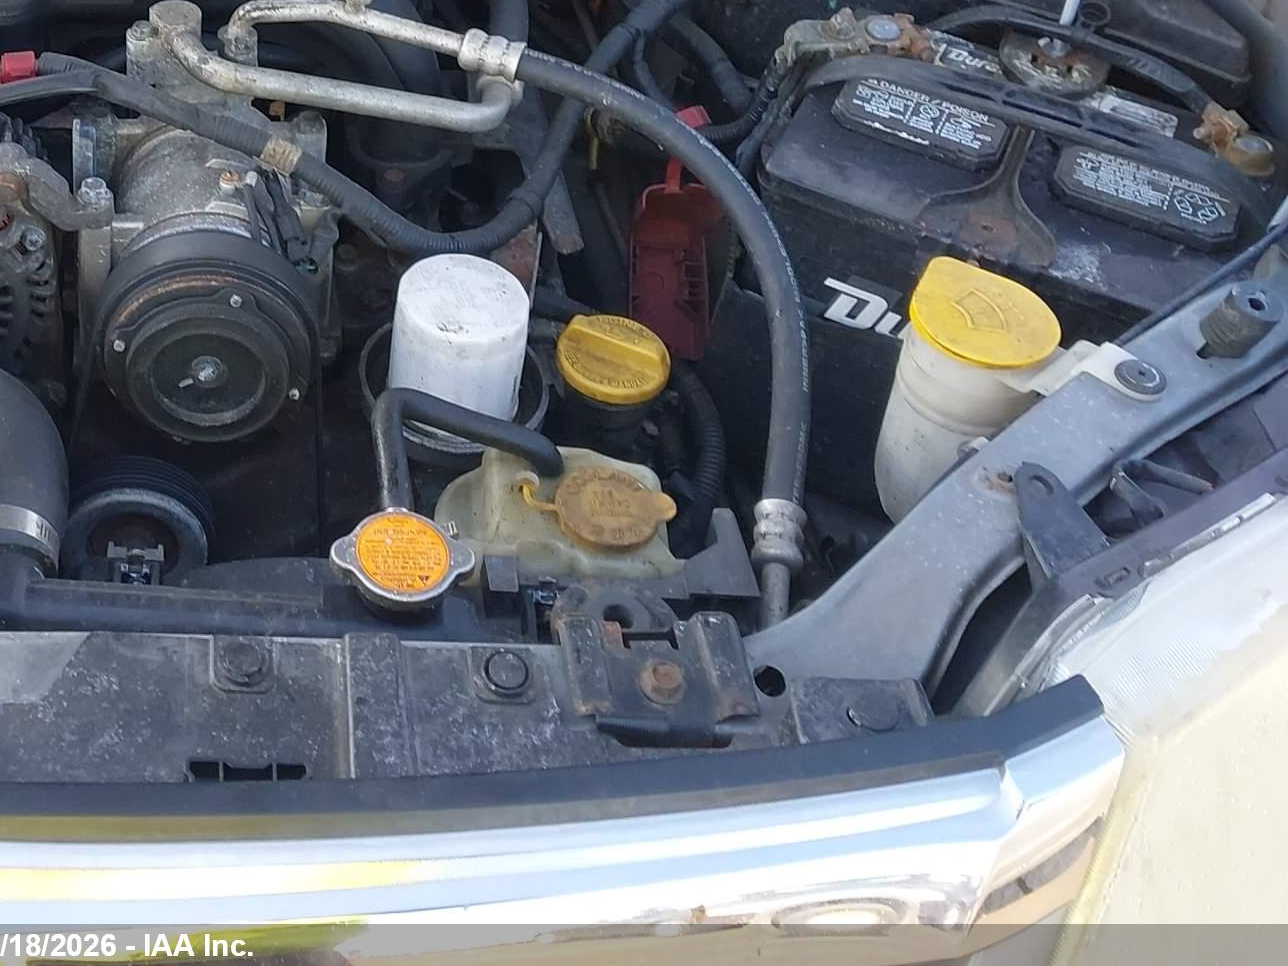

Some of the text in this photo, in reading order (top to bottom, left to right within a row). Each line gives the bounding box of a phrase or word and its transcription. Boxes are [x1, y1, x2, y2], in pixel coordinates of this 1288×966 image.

[946, 47, 1006, 75] Dura
[879, 80, 931, 104] DANGER
[941, 101, 989, 122] POISON
